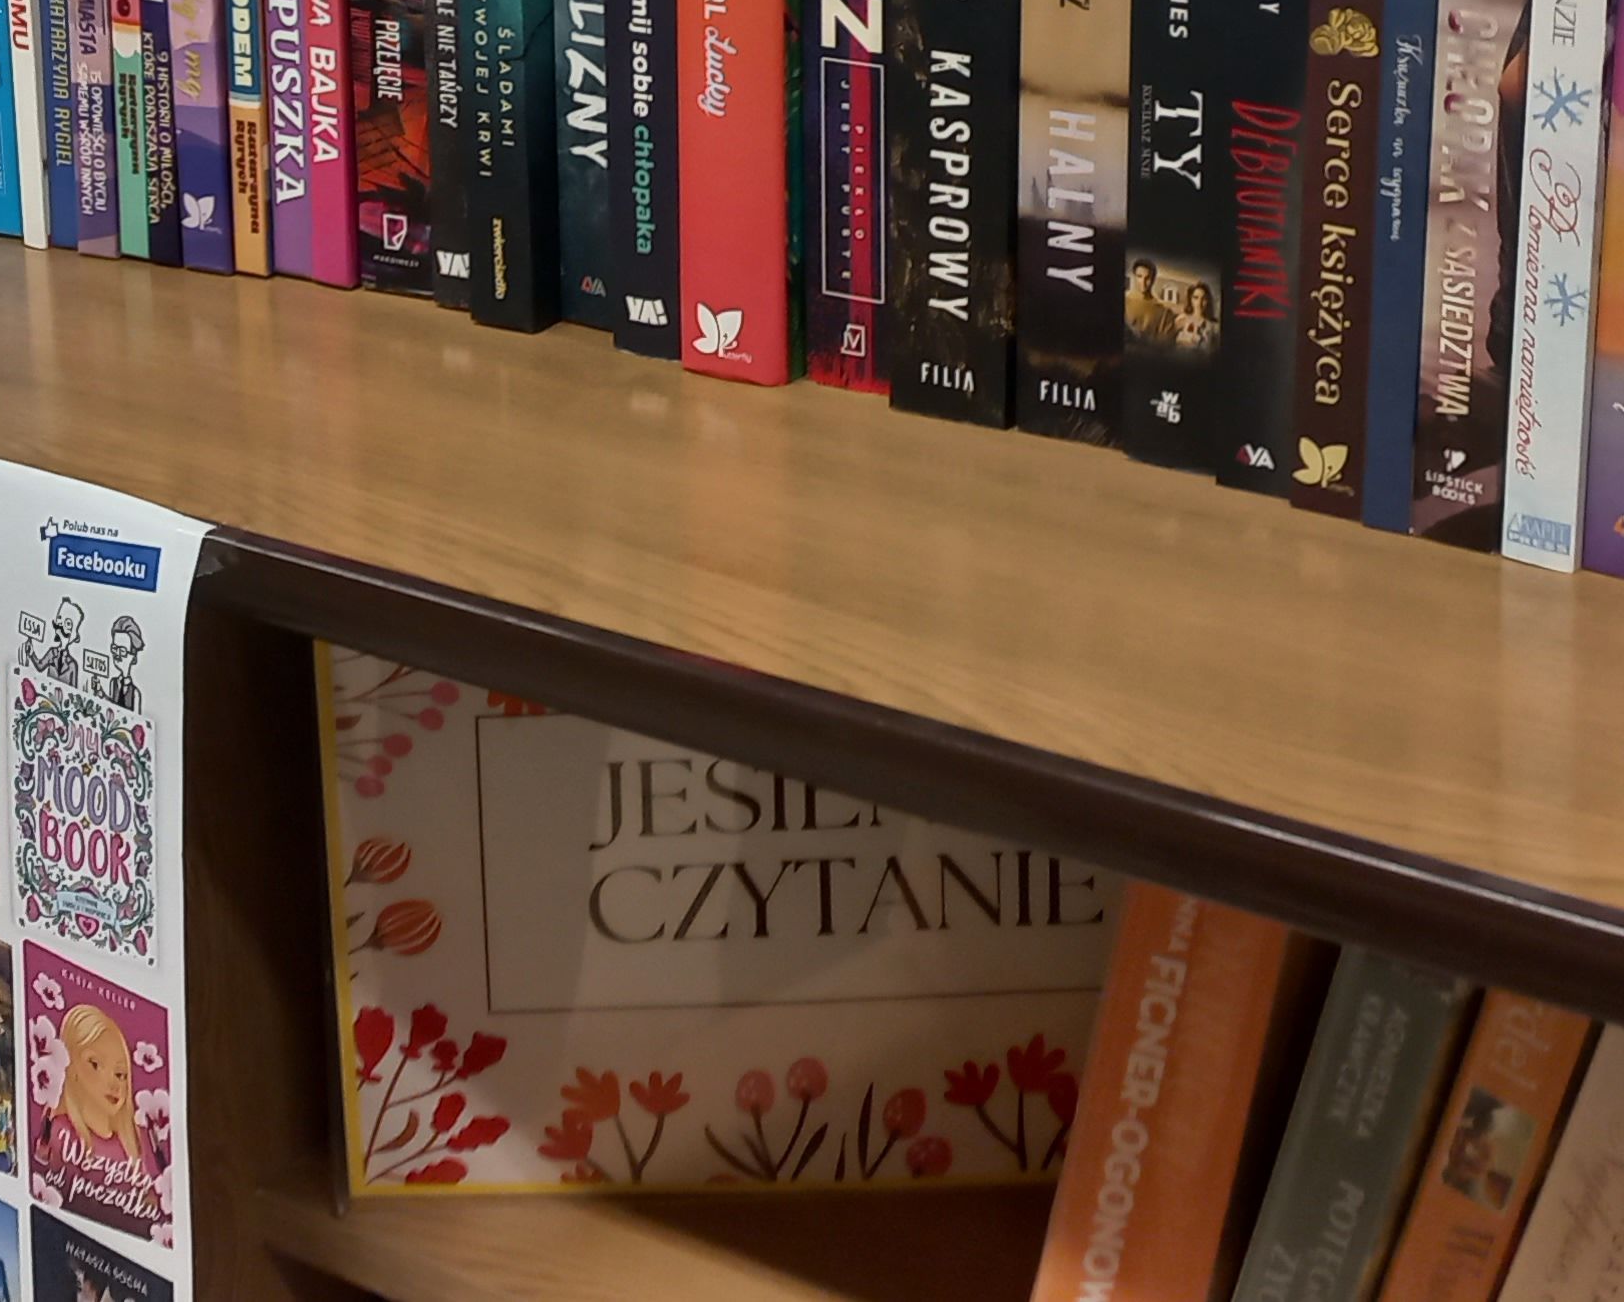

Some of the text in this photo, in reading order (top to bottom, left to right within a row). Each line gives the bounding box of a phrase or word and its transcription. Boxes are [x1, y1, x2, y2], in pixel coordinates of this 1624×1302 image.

[308, 45, 340, 164] BAJKA
[630, 40, 655, 119] sobie
[631, 124, 656, 255] chłopaka
[927, 49, 972, 322] KASPROWY
[1152, 89, 1205, 192] TY
[1045, 109, 1098, 294] HALNY
[1306, 78, 1363, 406] Serce księżyca
[57, 547, 147, 580] Facebooku
[585, 851, 1106, 946] CZYTANIE
